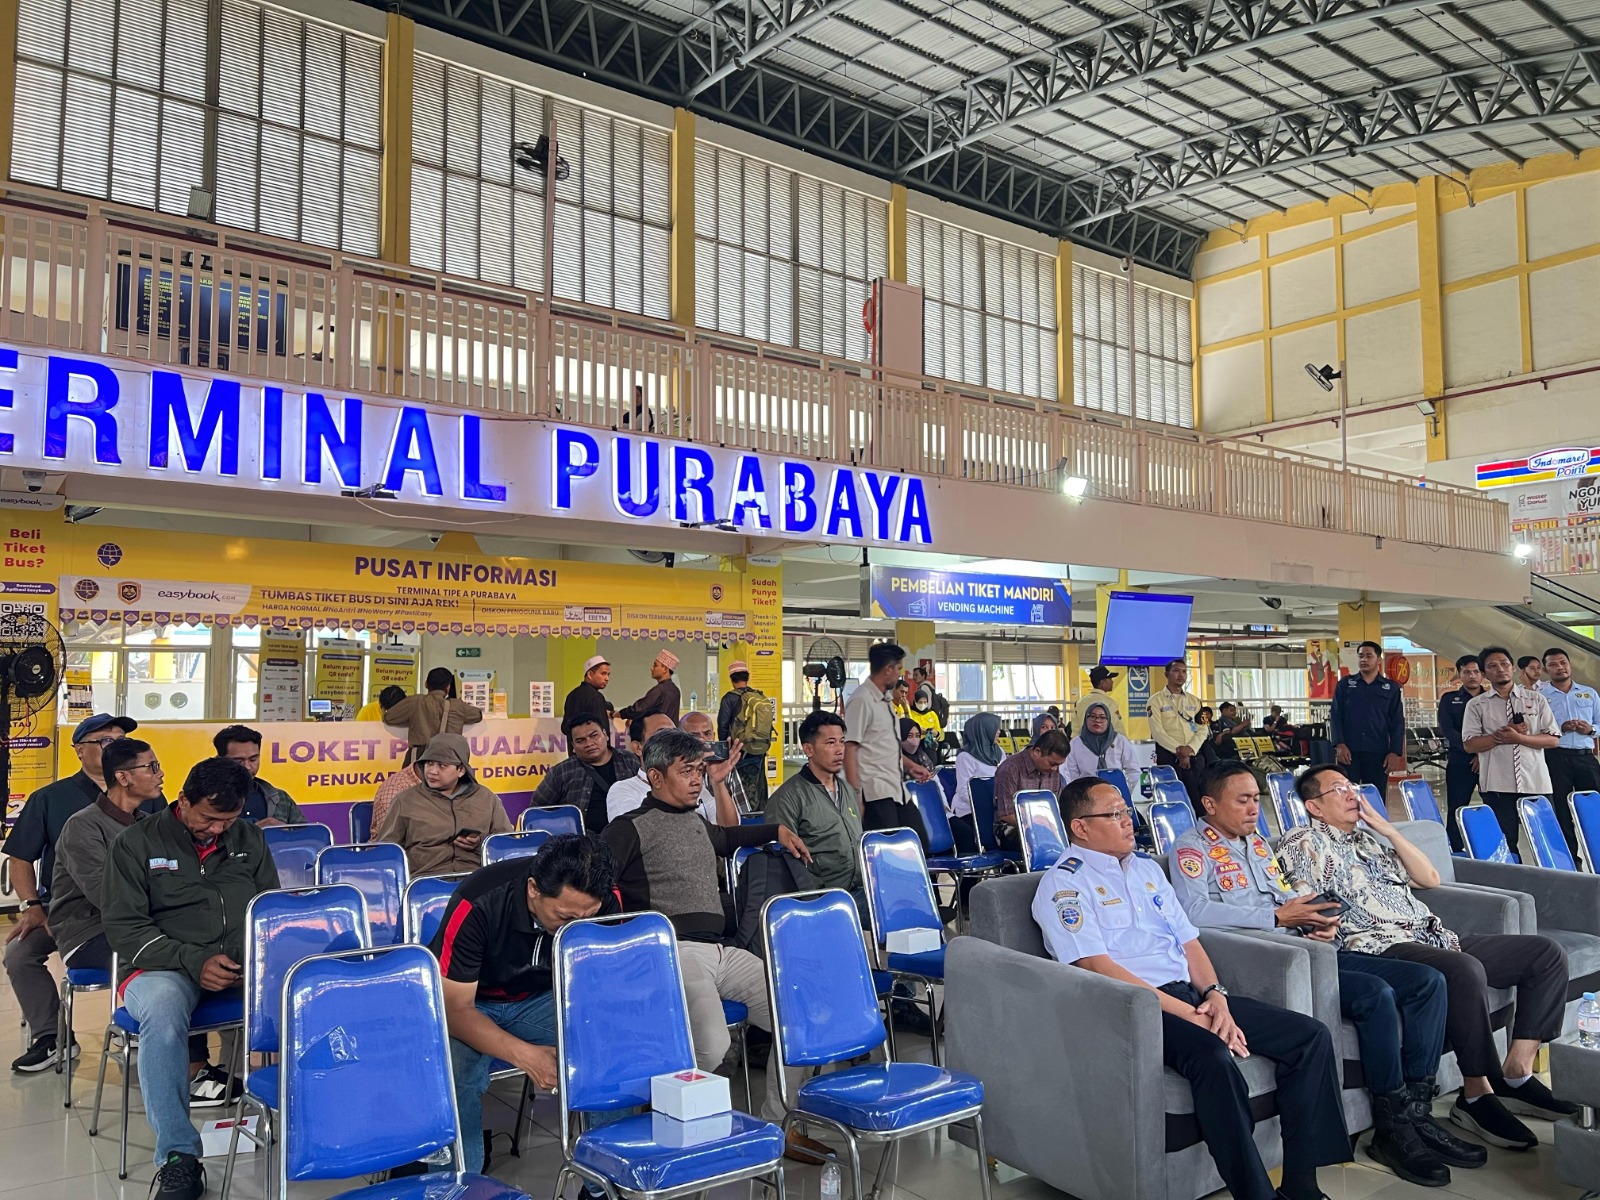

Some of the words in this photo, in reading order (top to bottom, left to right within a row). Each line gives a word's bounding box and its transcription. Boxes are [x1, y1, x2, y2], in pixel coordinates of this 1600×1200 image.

[1532, 453, 1586, 468] Indomaret
[1556, 465, 1586, 477] Point
[551, 428, 933, 545] PURABAYA
[10, 528, 41, 539] Beli
[3, 542, 46, 553] Tiket
[4, 557, 44, 568] Bus?
[354, 556, 433, 579] PUSAT
[437, 562, 558, 587] INFORMASI
[751, 578, 777, 587] Sudah
[891, 577, 965, 596] PEMBELIAN
[967, 581, 1000, 599] TIKET
[1003, 585, 1054, 602] MANDIRI
[260, 590, 312, 601] TUMBAS
[315, 592, 347, 603] TIKET
[349, 594, 372, 604] BUS
[374, 596, 386, 605] DI
[387, 597, 410, 606] SINI
[411, 598, 435, 607] AJA
[436, 599, 460, 608] REK!
[396, 586, 442, 596] TERMINAL
[444, 589, 461, 597] TIPE
[471, 591, 517, 600] PURABAYA
[752, 588, 777, 598] Punya
[752, 598, 776, 606] Tiket?
[937, 601, 975, 614] VENDING
[976, 604, 1014, 616] MACHINE
[291, 605, 322, 613] NORMAL
[357, 608, 394, 617] #NoWorry
[271, 740, 381, 763] LOKET
[482, 764, 549, 778] DENGAN
[194, 1080, 226, 1099] N
